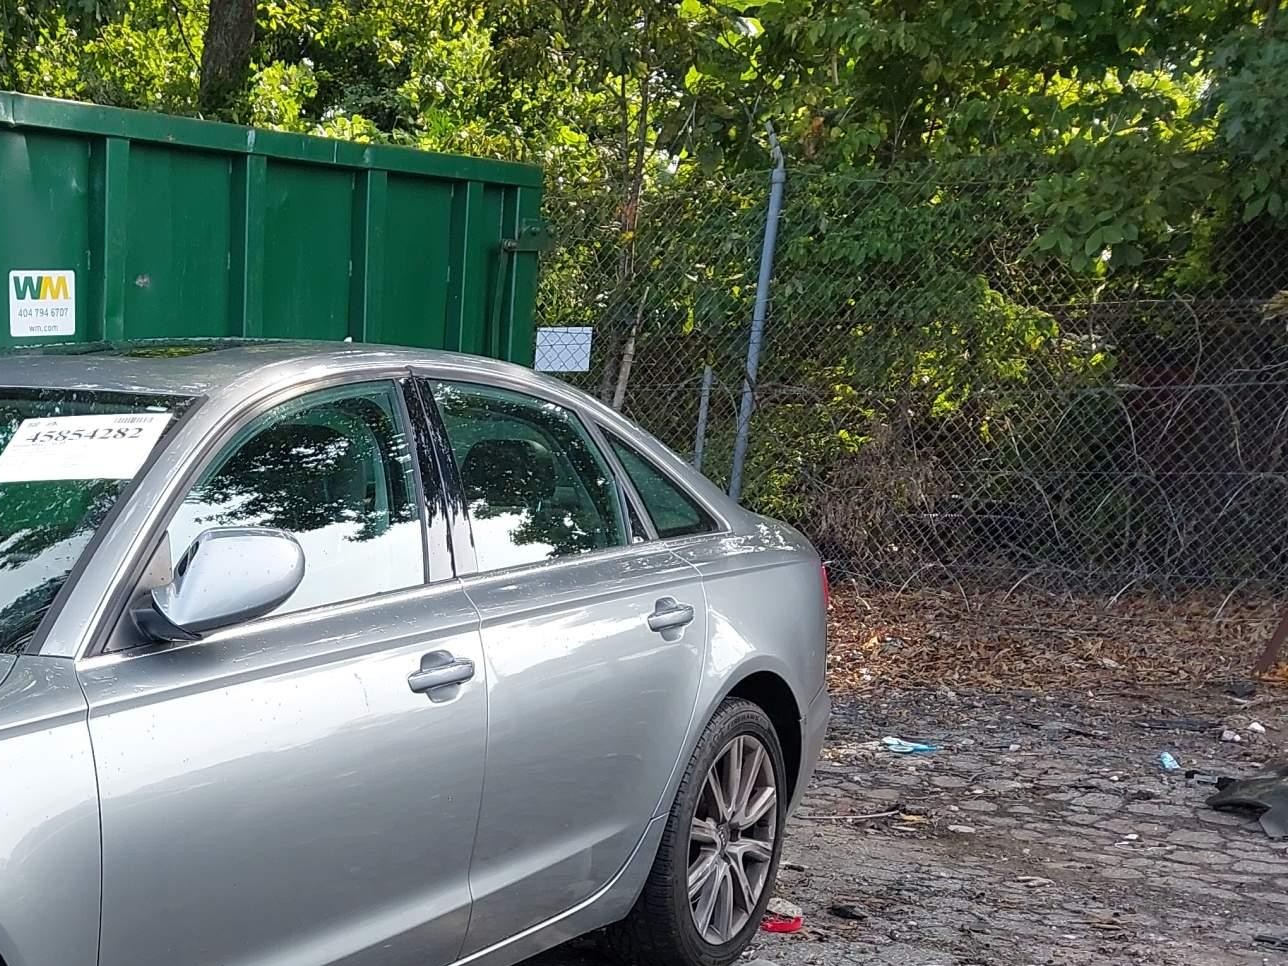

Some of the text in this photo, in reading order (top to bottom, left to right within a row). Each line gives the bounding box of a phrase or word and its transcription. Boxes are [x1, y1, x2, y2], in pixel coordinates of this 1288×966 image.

[13, 276, 70, 300] WM
[18, 307, 69, 318] 404 794 6707
[26, 427, 143, 443] 45854282
